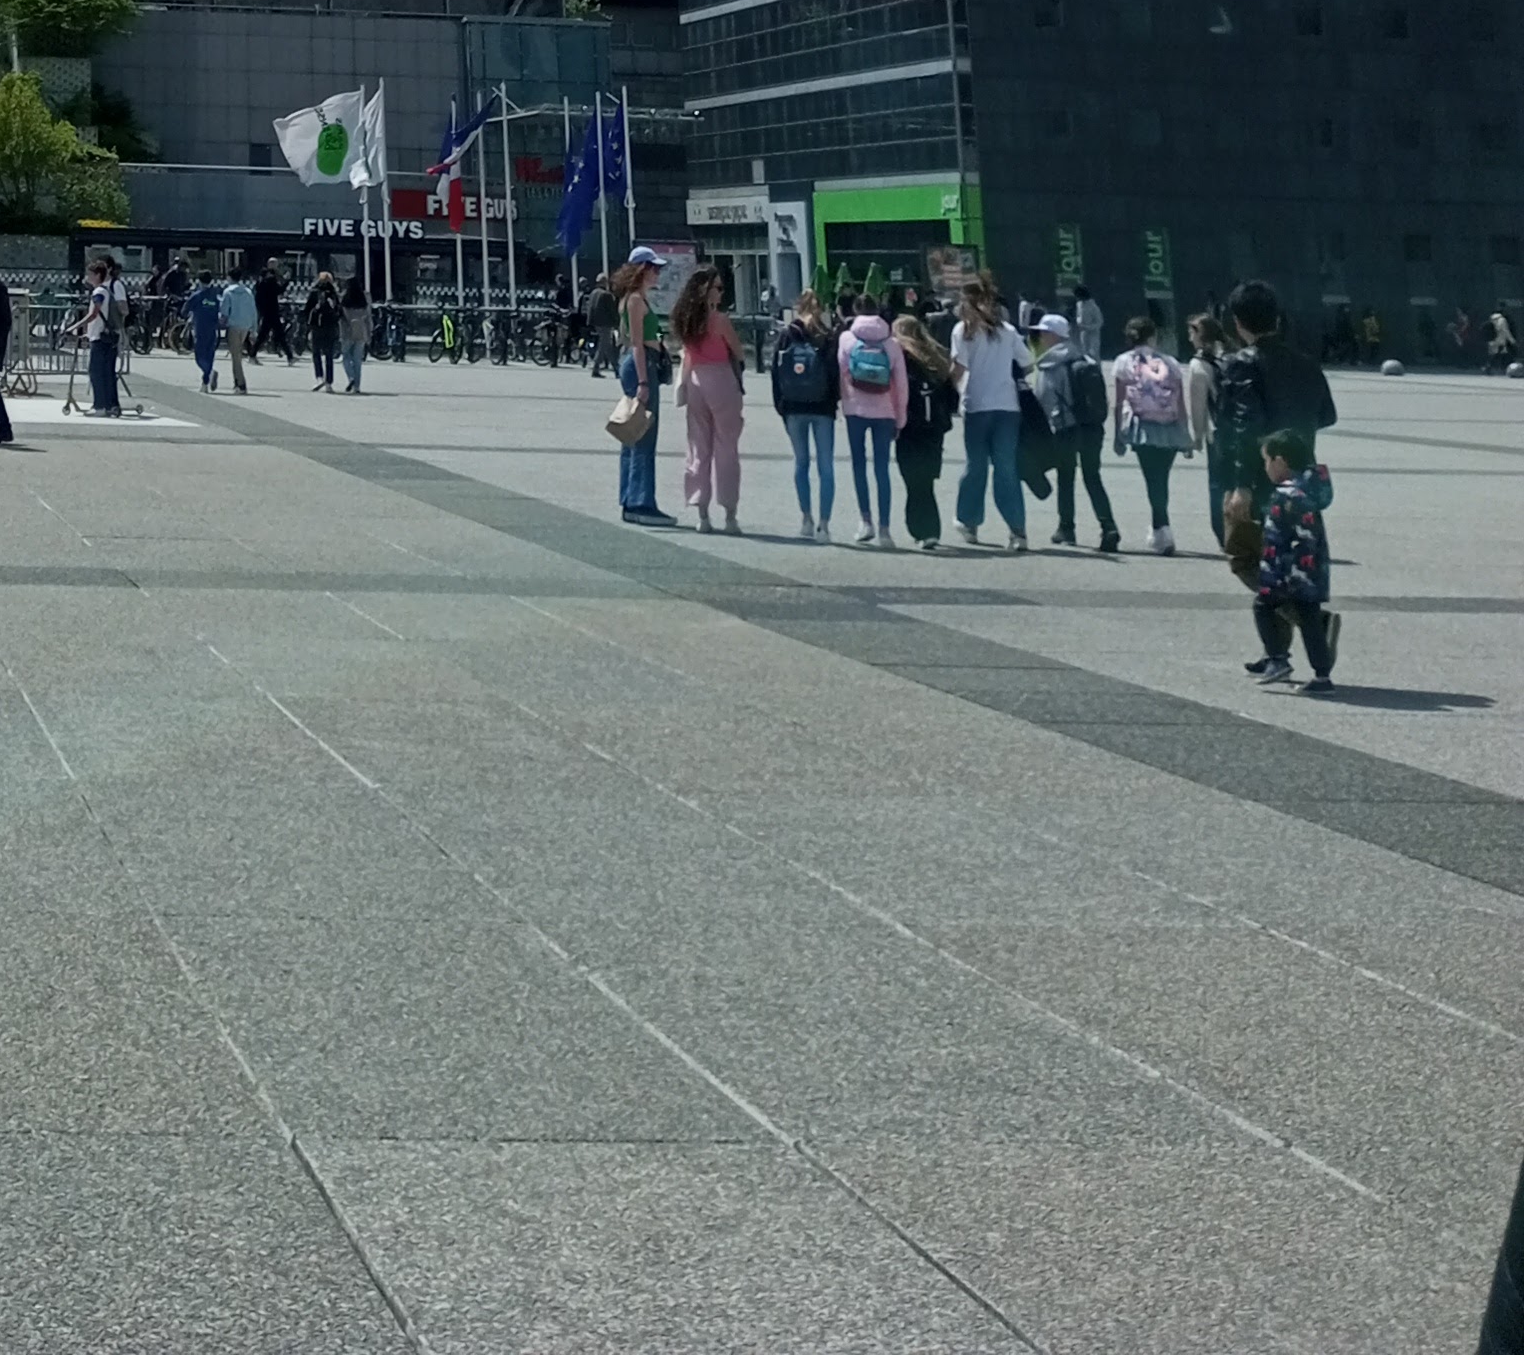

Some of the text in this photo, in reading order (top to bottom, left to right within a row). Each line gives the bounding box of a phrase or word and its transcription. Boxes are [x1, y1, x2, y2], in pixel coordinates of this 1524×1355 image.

[426, 195, 478, 217] FIE
[303, 218, 424, 239] FIVE GUYS
